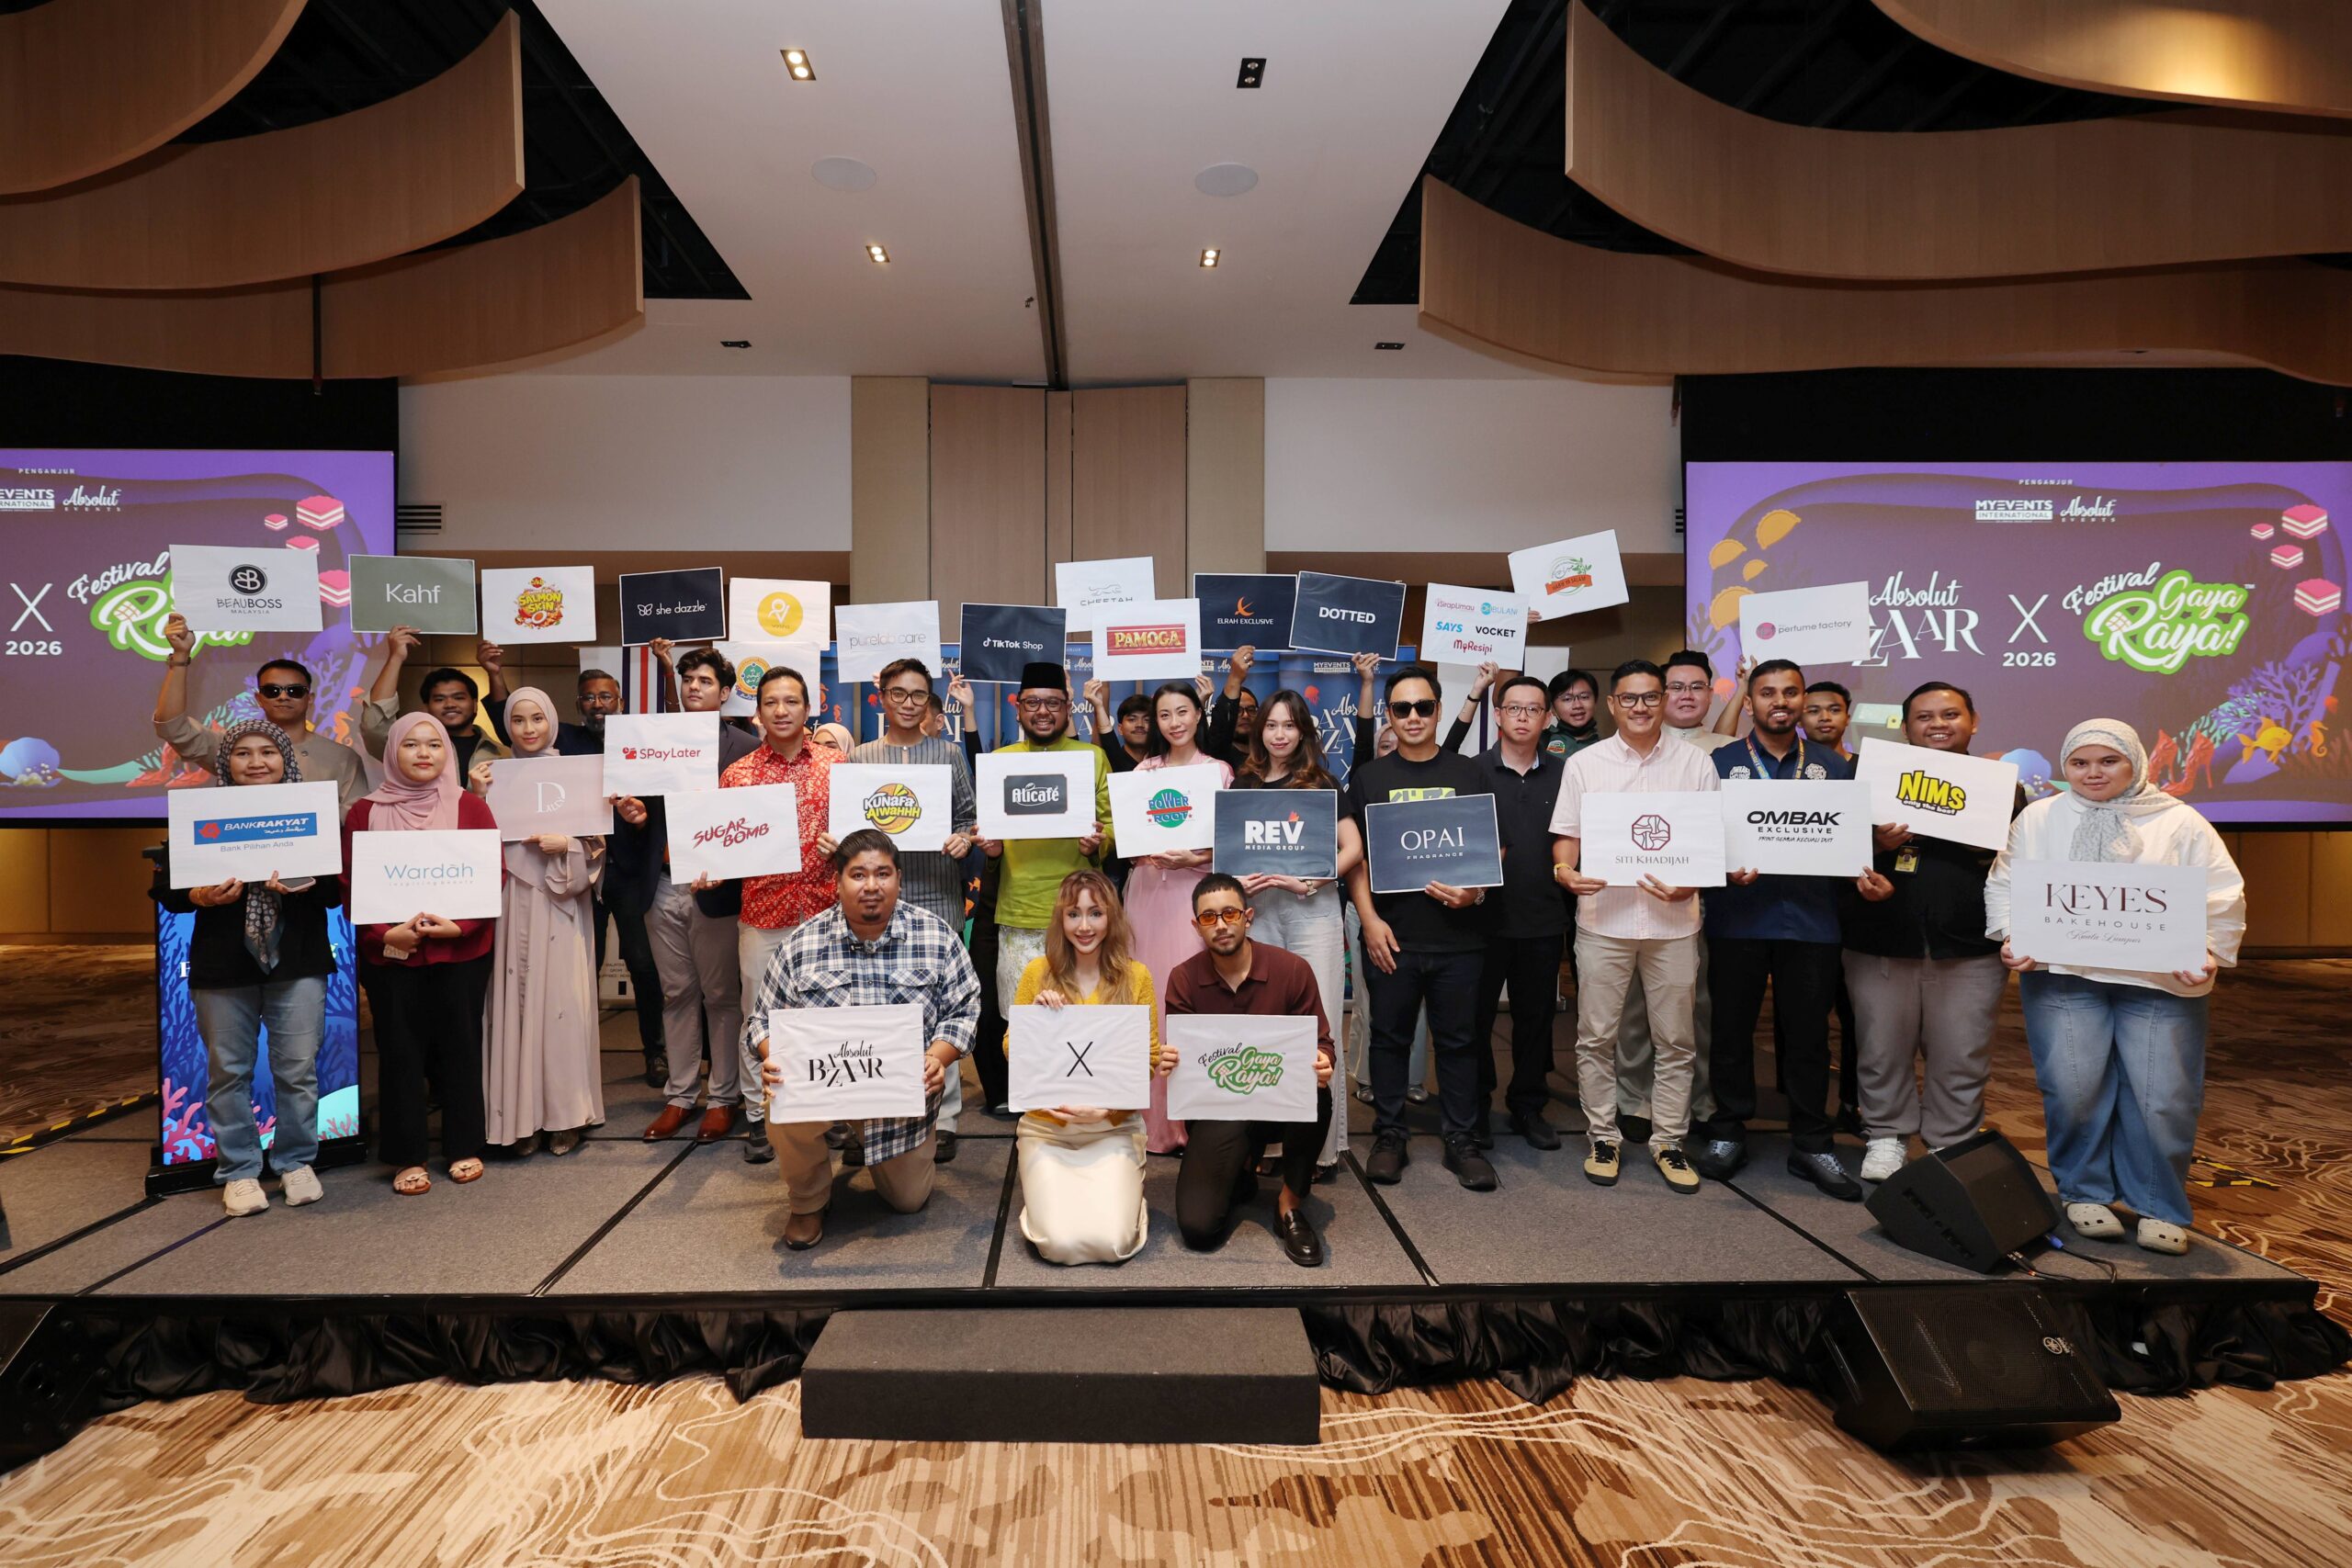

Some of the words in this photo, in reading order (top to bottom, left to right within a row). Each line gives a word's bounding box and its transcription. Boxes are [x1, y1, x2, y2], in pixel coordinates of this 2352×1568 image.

[62, 485, 122, 507] Absolut
[1975, 500, 2053, 511] MYEVENTS
[2060, 495, 2115, 517] Absolut
[67, 550, 170, 606] Festival
[386, 582, 442, 604] Kahf
[1869, 570, 1963, 608] Absolut
[2062, 561, 2161, 615] Festival
[2159, 575, 2245, 620] Gaya
[10, 582, 53, 633] X
[217, 597, 283, 609] BEAUBOSS
[517, 592, 562, 607] SALMON
[655, 602, 672, 615] she
[674, 599, 707, 615] dazzle
[1080, 596, 1133, 606] CHEETAH
[1217, 617, 1238, 626] ELRAH
[1240, 617, 1273, 626] EXCLUSIVE
[1318, 605, 1376, 624] DOTTED
[2007, 593, 2050, 644] X
[1435, 620, 1464, 633] SAYS
[1475, 626, 1516, 638] VOCKET
[1778, 624, 1817, 635] perfume
[1818, 619, 1852, 630] factory
[2091, 597, 2245, 670] Raya!
[898, 632, 927, 645] care
[992, 638, 1020, 649] TikTok
[1023, 640, 1044, 652] Shop
[1114, 630, 1182, 649] PAMOGA
[5, 640, 63, 657] 2026
[2001, 651, 2057, 667] 2026
[639, 747, 701, 762] SPayLater
[1012, 784, 1059, 804] Alicafé
[1896, 770, 1967, 811] NIMS
[1148, 792, 1190, 810] POWER
[1902, 798, 1922, 808] only
[1922, 802, 1936, 812] the
[1936, 805, 1958, 816] best
[1152, 811, 1188, 823] ROOT
[1747, 810, 1842, 826] OMBAK
[692, 817, 753, 850] SUGAR
[722, 823, 771, 848] BOMB
[1245, 820, 1305, 845] REV
[1400, 826, 1464, 851] OPAI
[1758, 826, 1833, 834] EXCLUSIVE
[220, 844, 242, 852] Bank
[243, 842, 271, 851] Pilihan
[1407, 852, 1464, 861] FRAGRANCE
[1615, 855, 1633, 864] SITI
[1636, 855, 1690, 866] KHADIJAH
[2045, 883, 2168, 916] KEYES
[2044, 916, 2166, 931] BAKEHOUSE
[833, 1039, 875, 1058] Absolut
[1197, 1042, 1243, 1067] Festival
[1066, 1040, 1094, 1077] X
[1241, 1048, 1282, 1070] Gaya
[1211, 1058, 1283, 1093] Raya!
